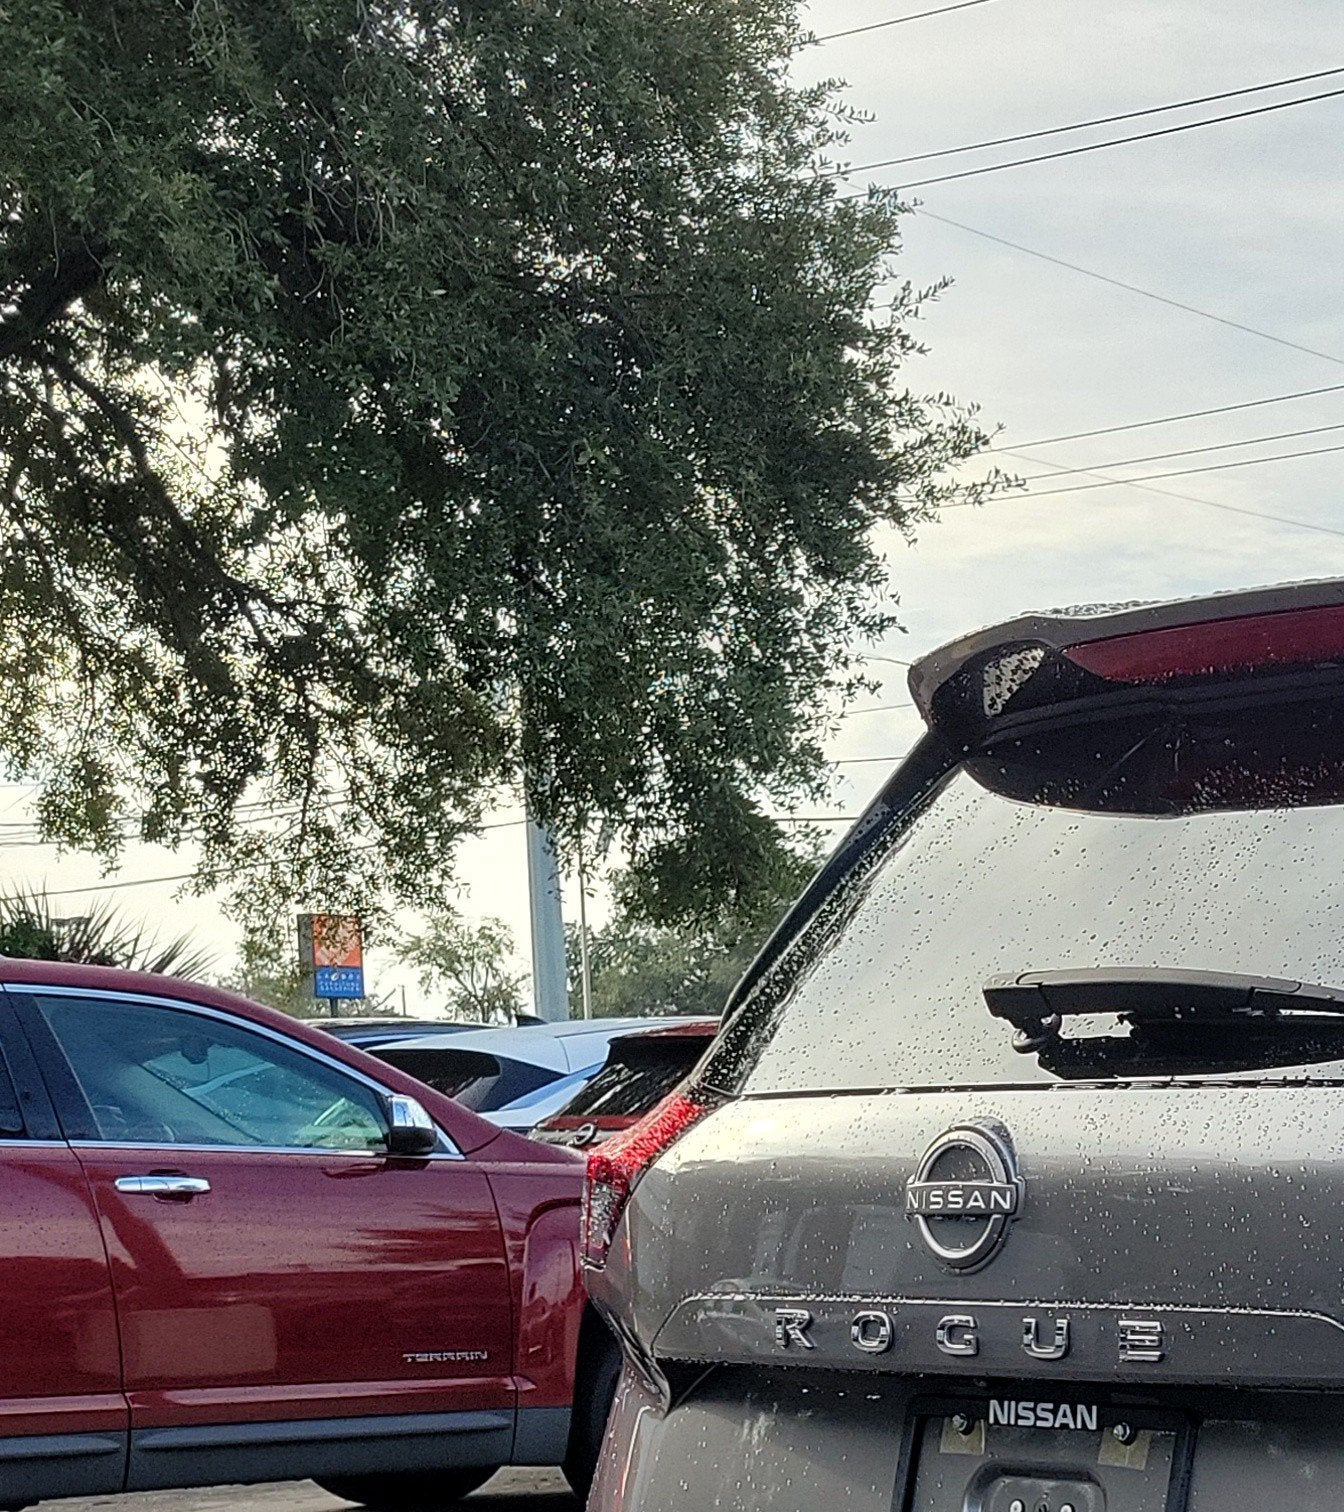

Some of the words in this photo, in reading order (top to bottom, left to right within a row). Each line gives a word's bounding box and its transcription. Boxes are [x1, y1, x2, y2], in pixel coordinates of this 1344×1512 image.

[906, 1189, 1012, 1211] NISSAN
[775, 1307, 1165, 1363] ROGUE
[402, 1350, 488, 1363] TERRAIN
[988, 1399, 1098, 1430] NISSAN
